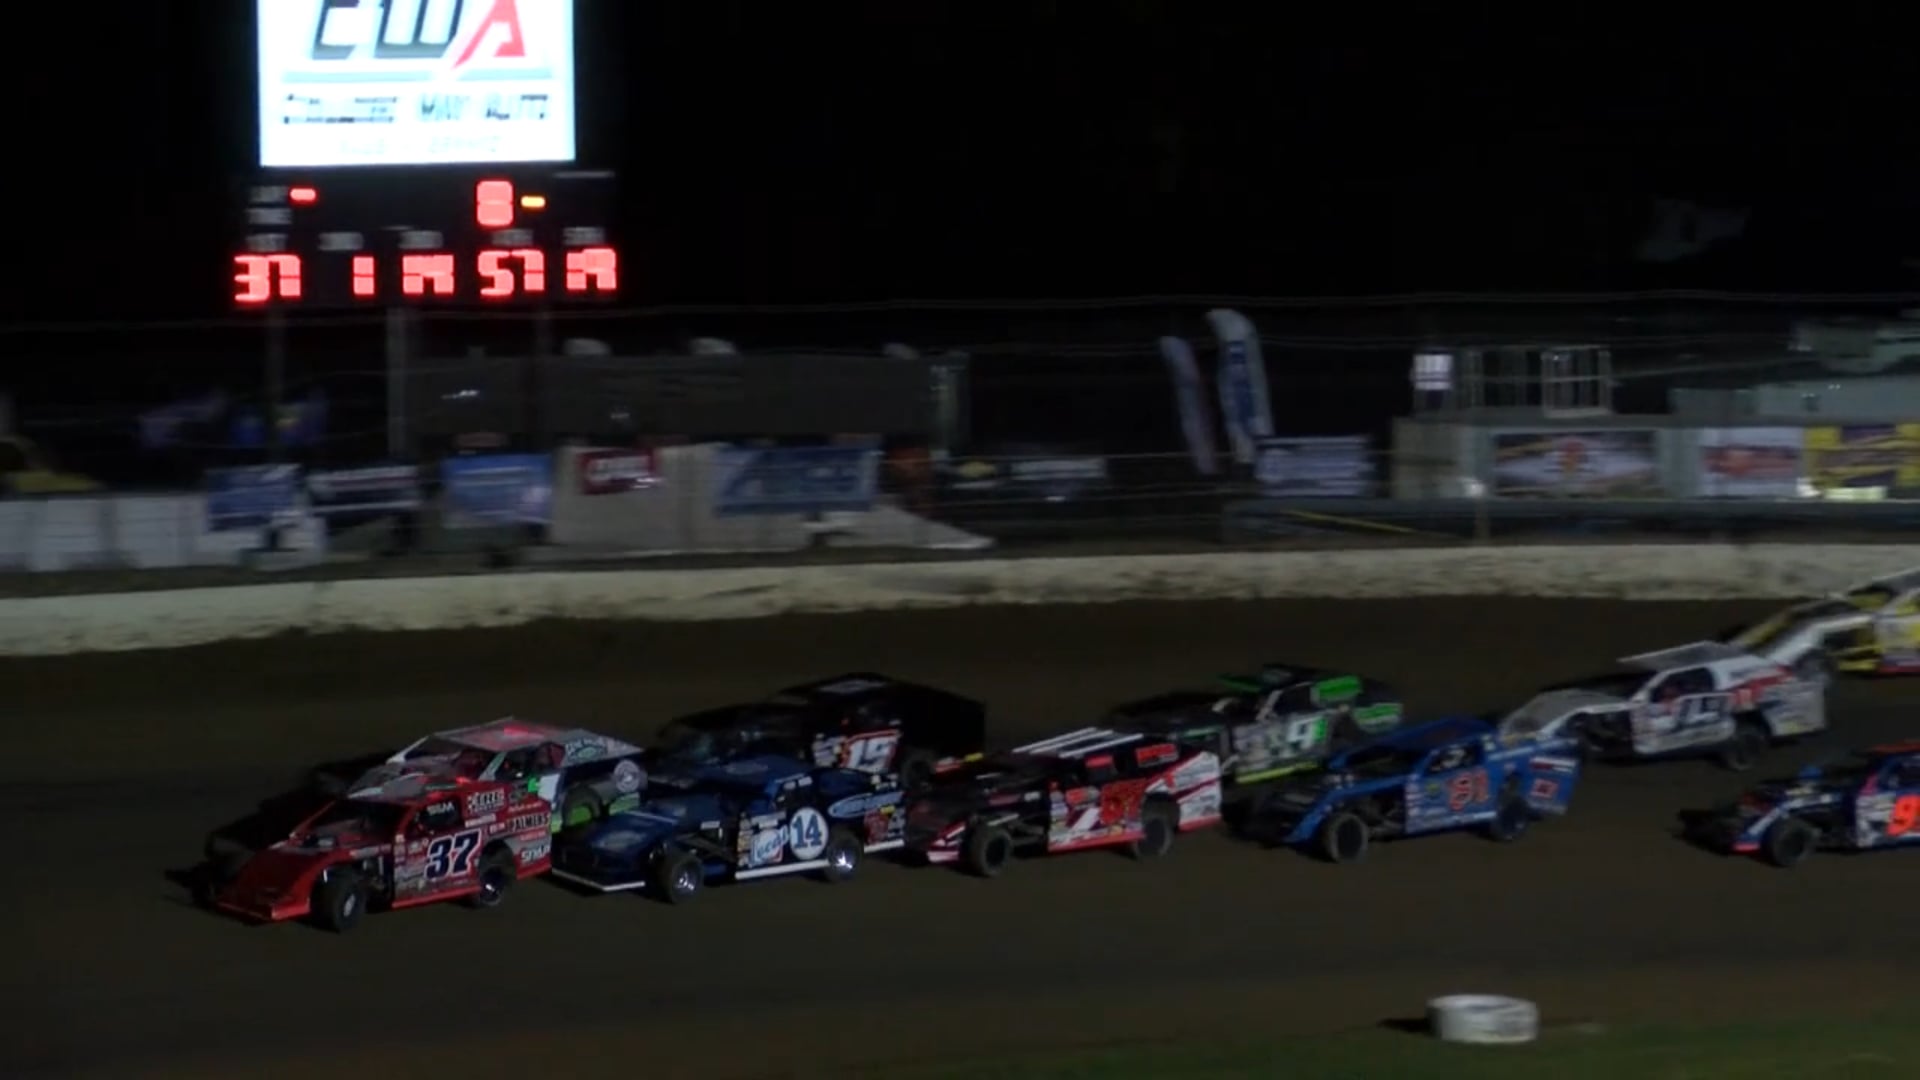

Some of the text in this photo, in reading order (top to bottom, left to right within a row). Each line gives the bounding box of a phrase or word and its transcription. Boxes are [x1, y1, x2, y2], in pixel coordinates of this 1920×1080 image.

[476, 180, 514, 228] 8
[234, 254, 301, 302] 37
[353, 256, 375, 295] 1
[477, 249, 545, 298] 57
[424, 828, 482, 880] 37
[792, 813, 822, 849] 14
